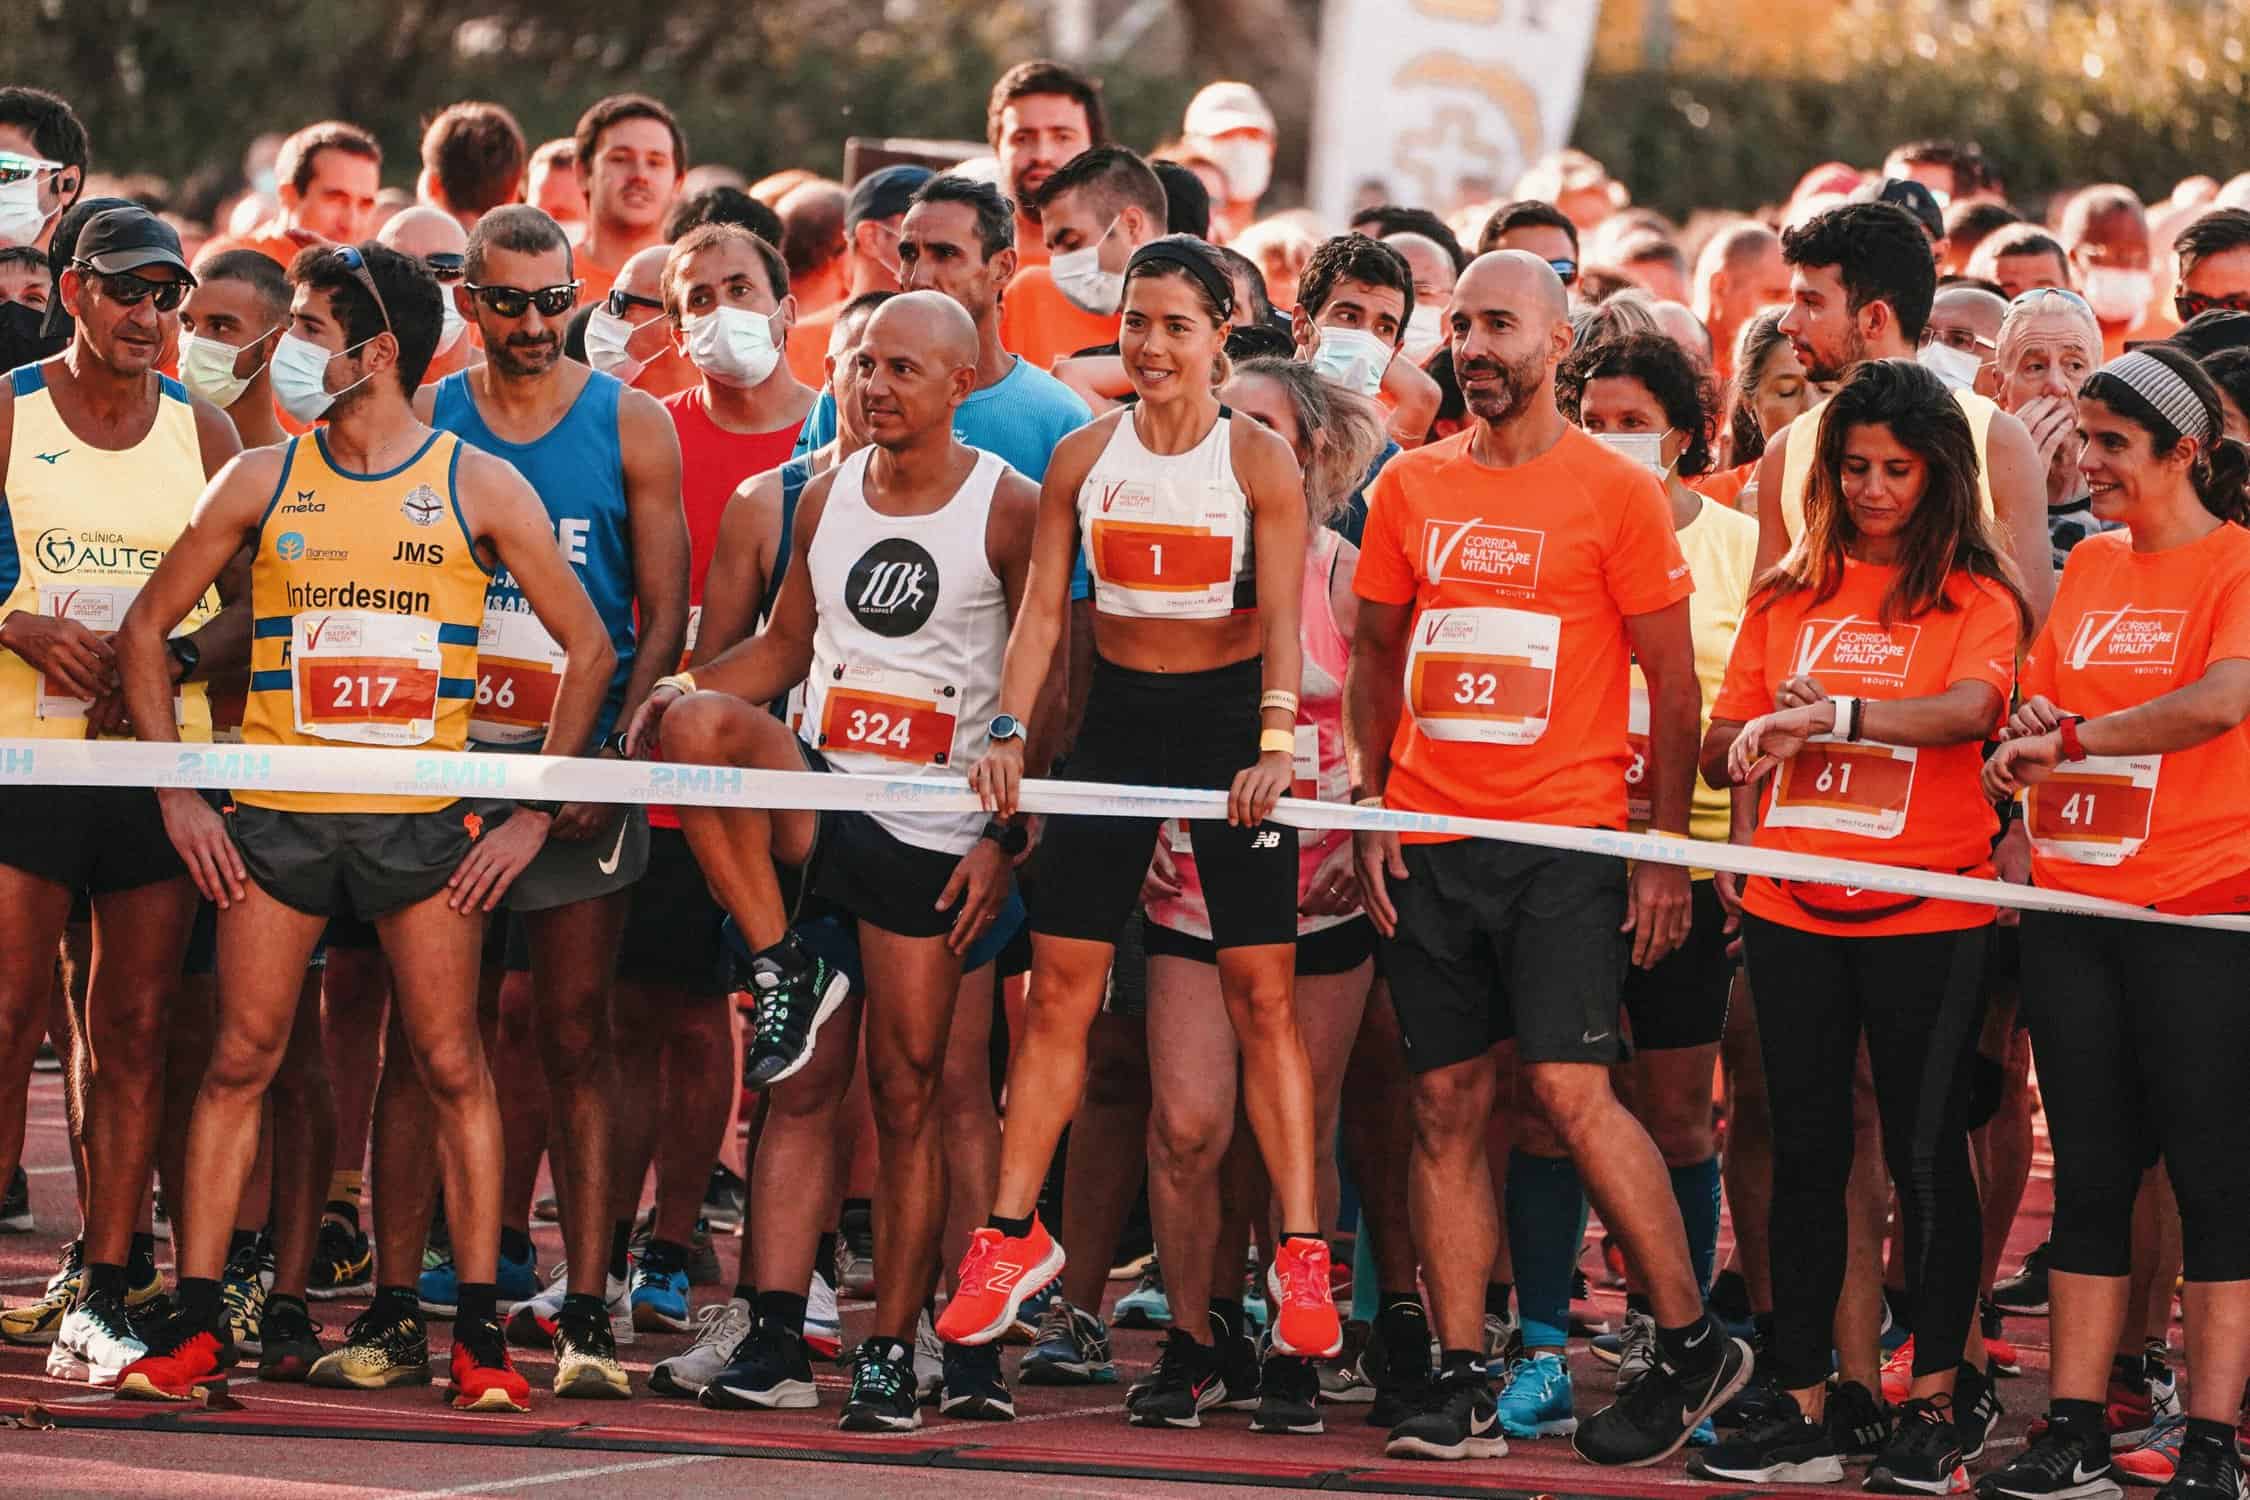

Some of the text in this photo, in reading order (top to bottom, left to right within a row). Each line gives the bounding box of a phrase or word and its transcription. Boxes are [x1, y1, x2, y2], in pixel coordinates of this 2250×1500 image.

[281, 502, 326, 513] meta
[80, 531, 124, 544] CLÍNICA
[1464, 535, 1518, 551] CORRIDA
[79, 547, 165, 570] AUTE
[392, 540, 444, 565] JMS
[1149, 543, 1163, 576] 1
[1461, 547, 1532, 566] MULTICARE
[1459, 559, 1516, 577] VITALITY
[286, 580, 430, 615] Interdesign
[2114, 620, 2163, 633] CORRIDA
[1838, 631, 1892, 645] CORRIDA
[2109, 631, 2176, 643] MULTICARE
[1834, 642, 1905, 657] MULTICARE
[2107, 642, 2159, 655] VITALITY
[1832, 653, 1888, 665] VITALITY
[332, 676, 399, 708] 217
[1453, 671, 1498, 706] 32
[846, 708, 912, 749] 324
[1815, 761, 1853, 794] 61
[2060, 792, 2097, 825] 41
